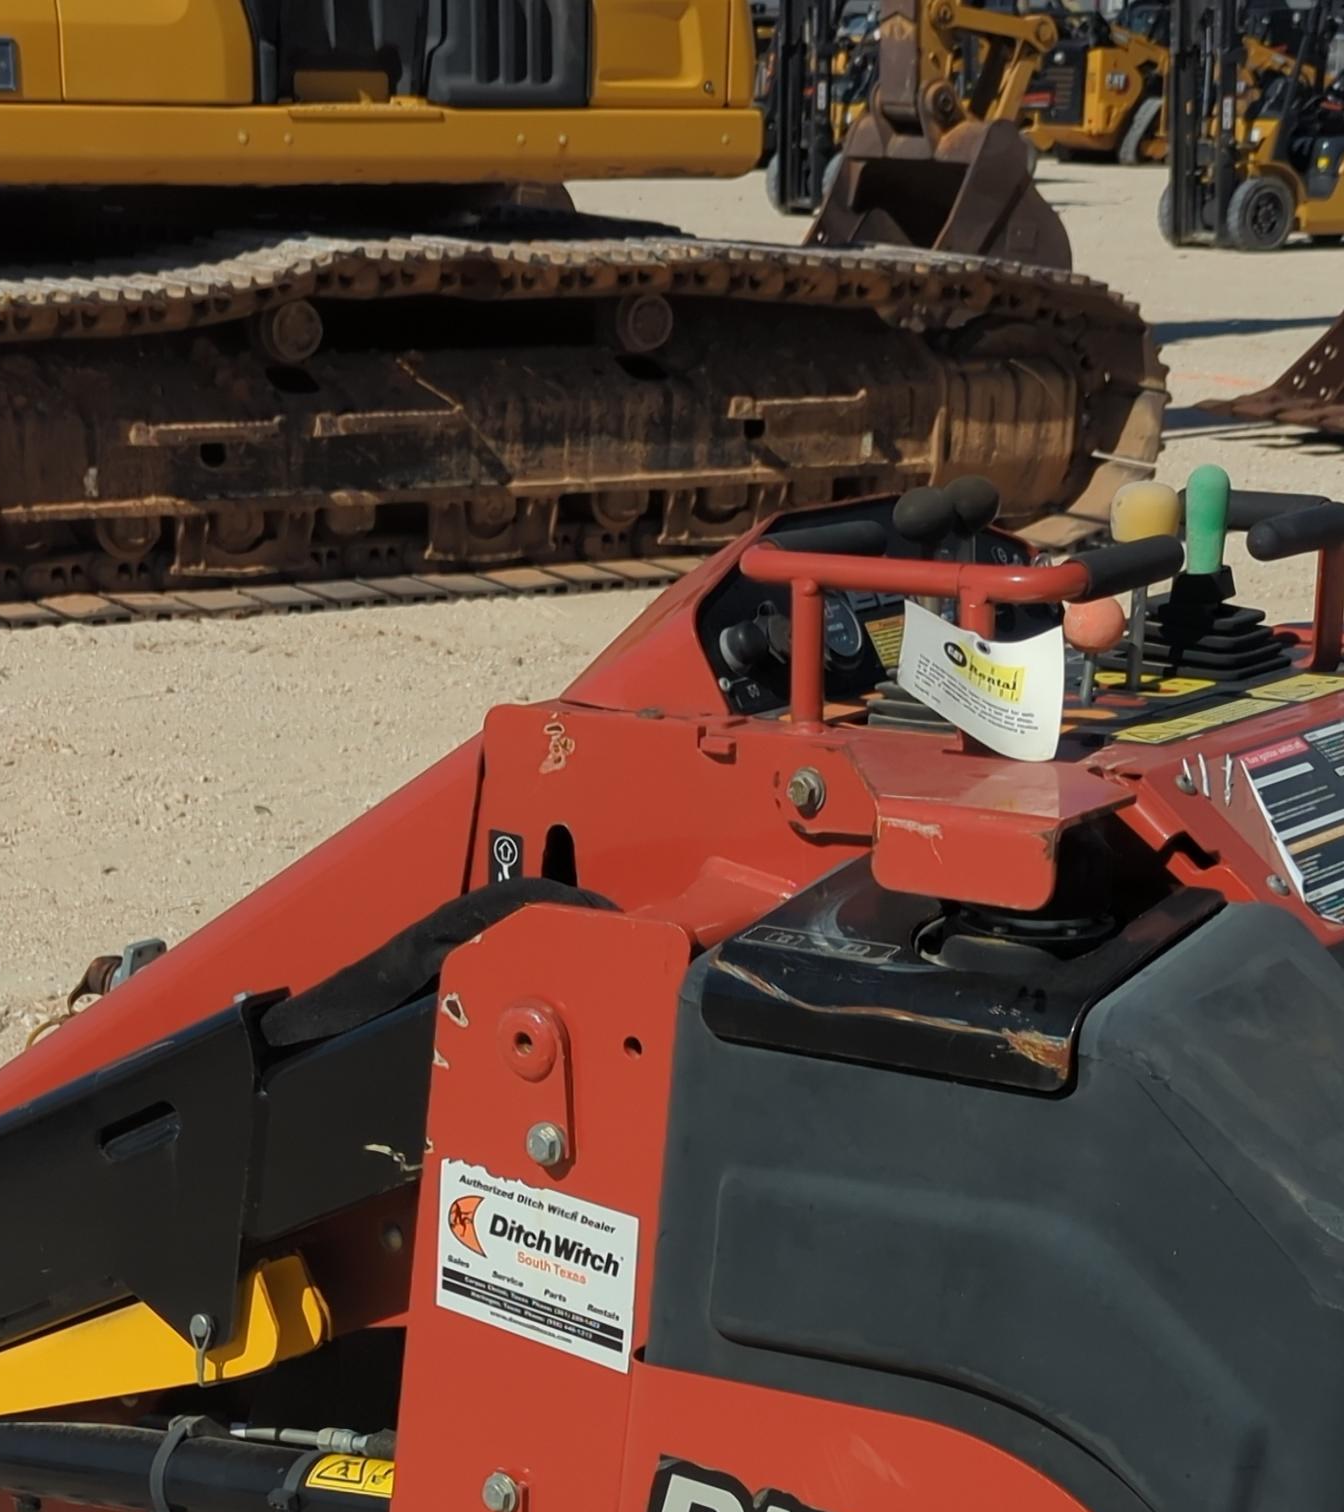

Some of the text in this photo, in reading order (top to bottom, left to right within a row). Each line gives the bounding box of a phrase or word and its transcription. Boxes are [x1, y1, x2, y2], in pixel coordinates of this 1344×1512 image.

[459, 1174, 514, 1200] Authorized
[517, 1193, 544, 1211] Ditch
[580, 1212, 616, 1234] Dealer
[517, 1251, 587, 1285] South Texas
[492, 1270, 524, 1287] Service
[544, 1288, 567, 1302] Parts
[587, 1303, 620, 1321] Rentals
